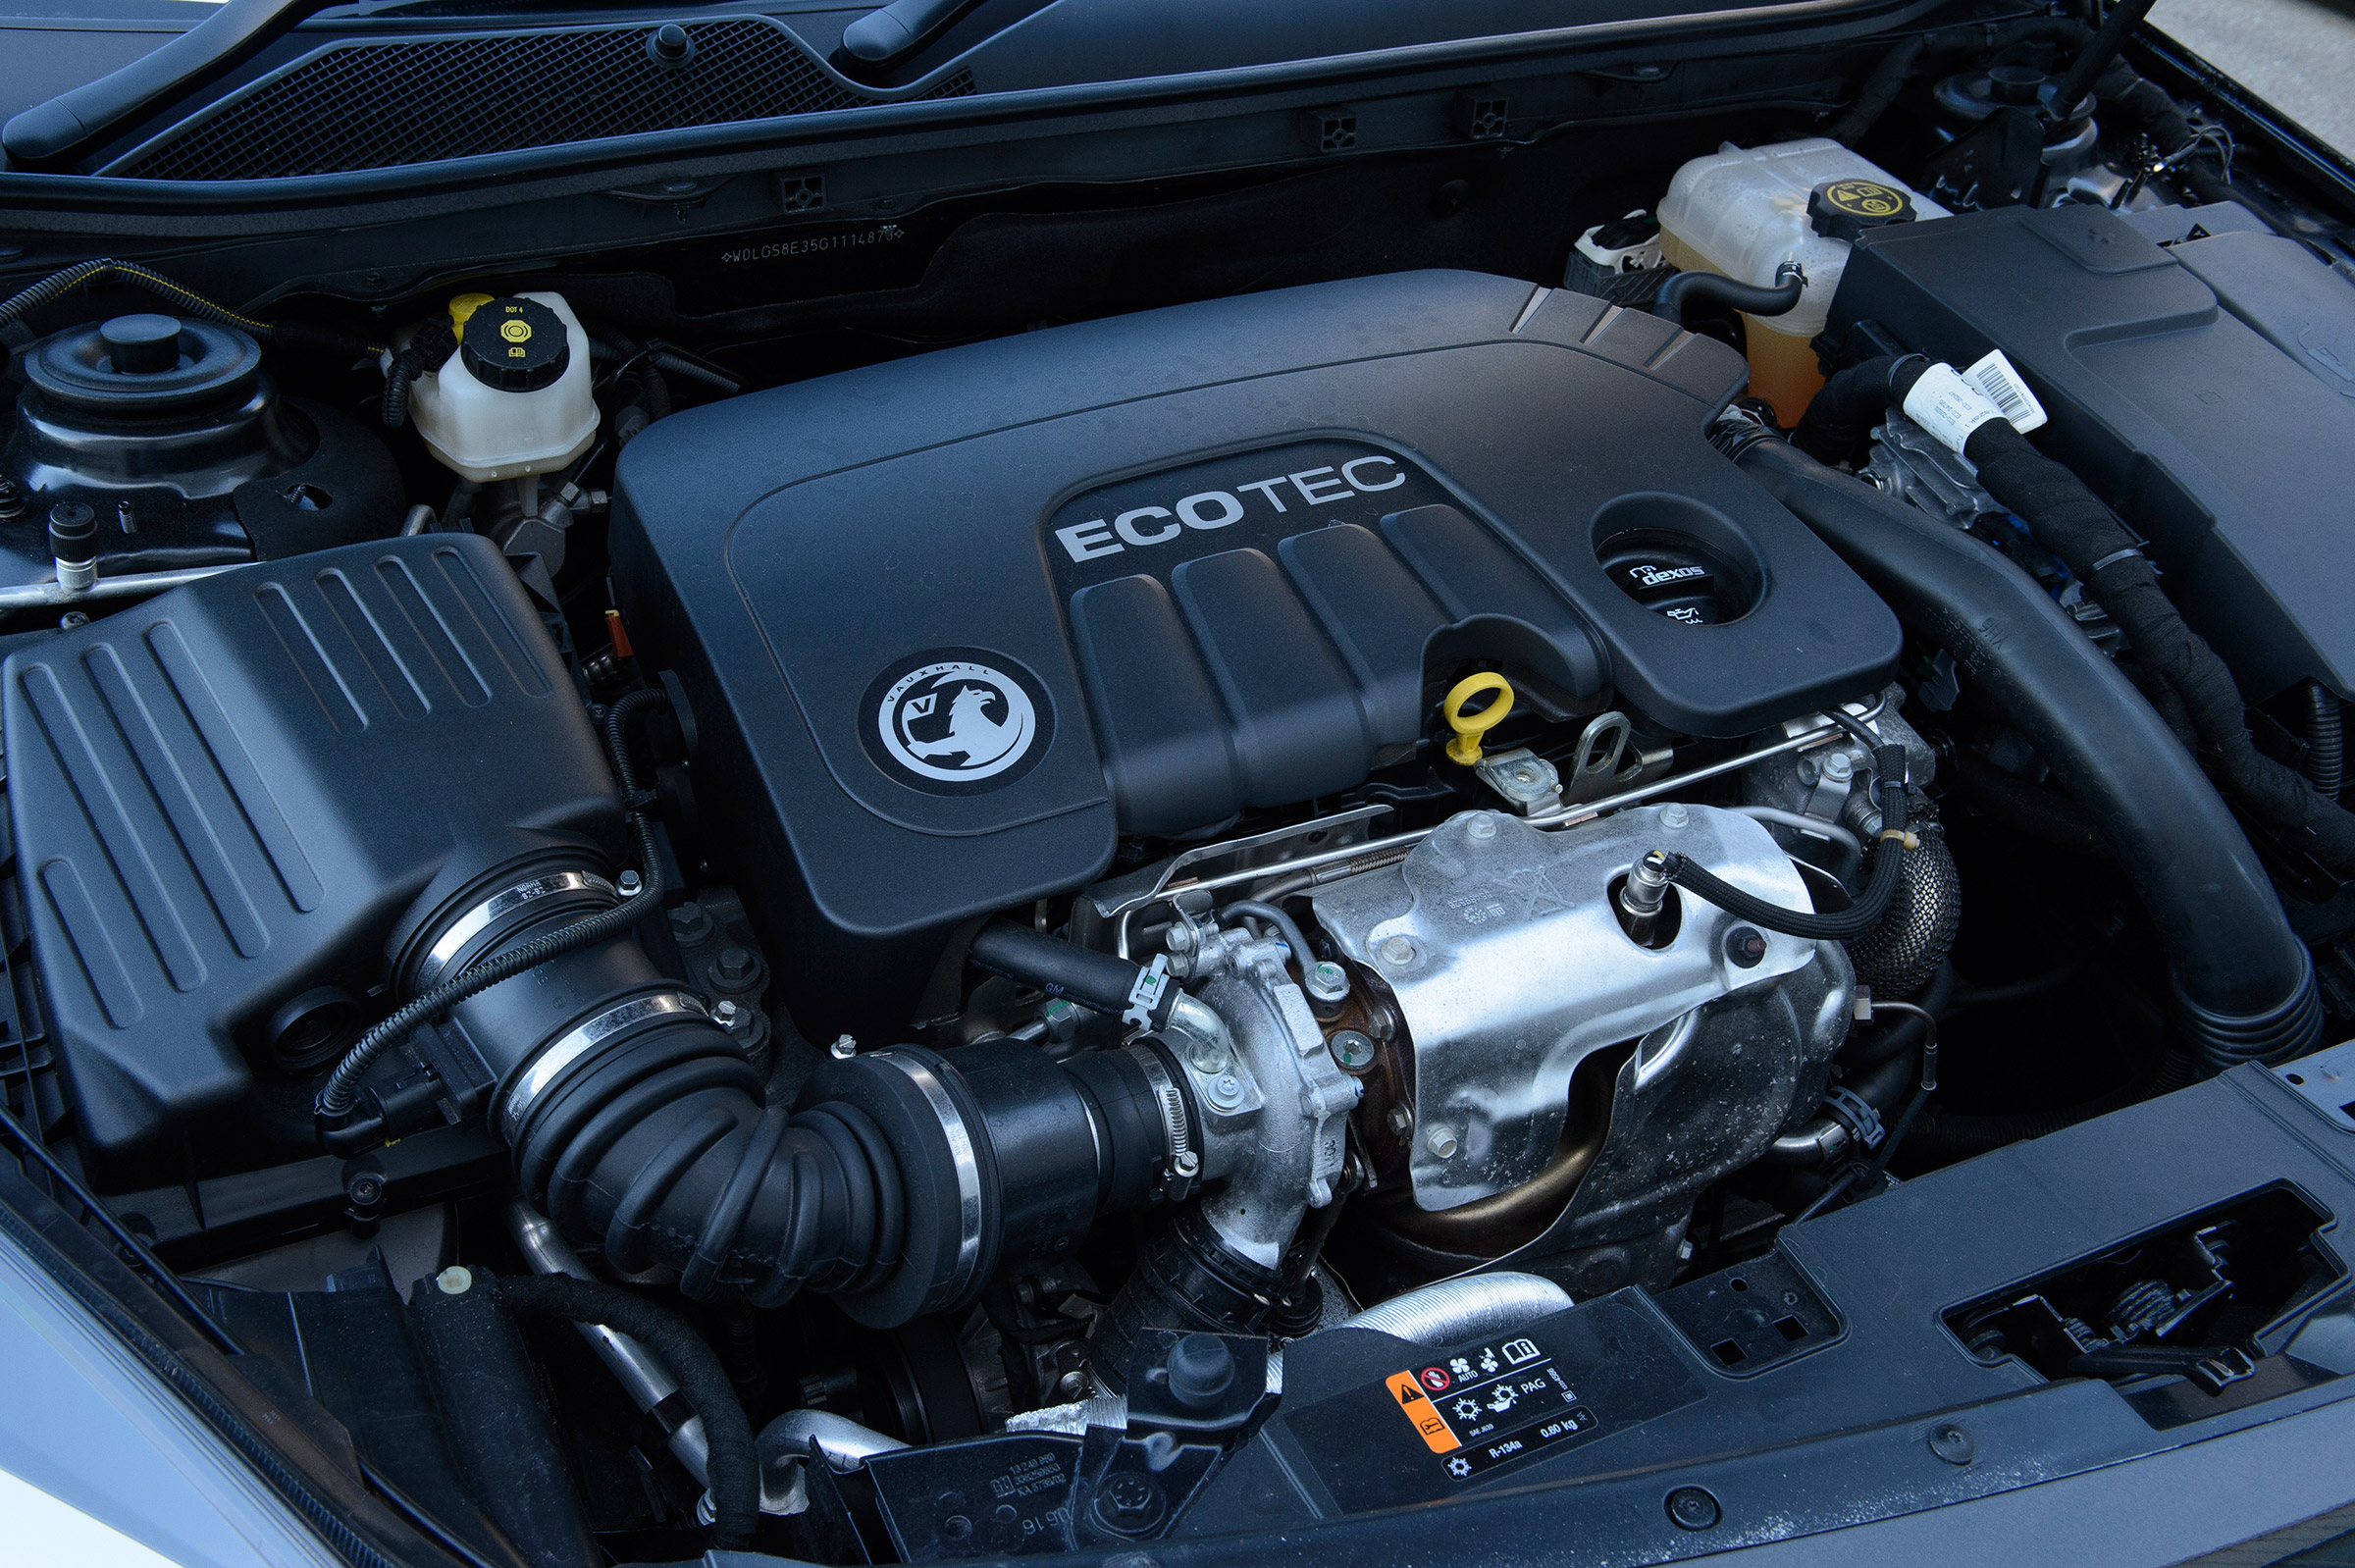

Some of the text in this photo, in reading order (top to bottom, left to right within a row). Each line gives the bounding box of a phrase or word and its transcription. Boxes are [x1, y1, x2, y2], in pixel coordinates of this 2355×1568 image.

[1054, 455, 1407, 563] ECOTEC
[1642, 565, 1706, 587] dexos
[887, 664, 990, 703] VAUXHALL
[516, 879, 542, 894] NORMA
[1457, 1370, 1479, 1384] AUTO
[1520, 1378, 1546, 1394] PAG
[1560, 1419, 1579, 1432] kg
[1489, 1439, 1523, 1459] R-134a
